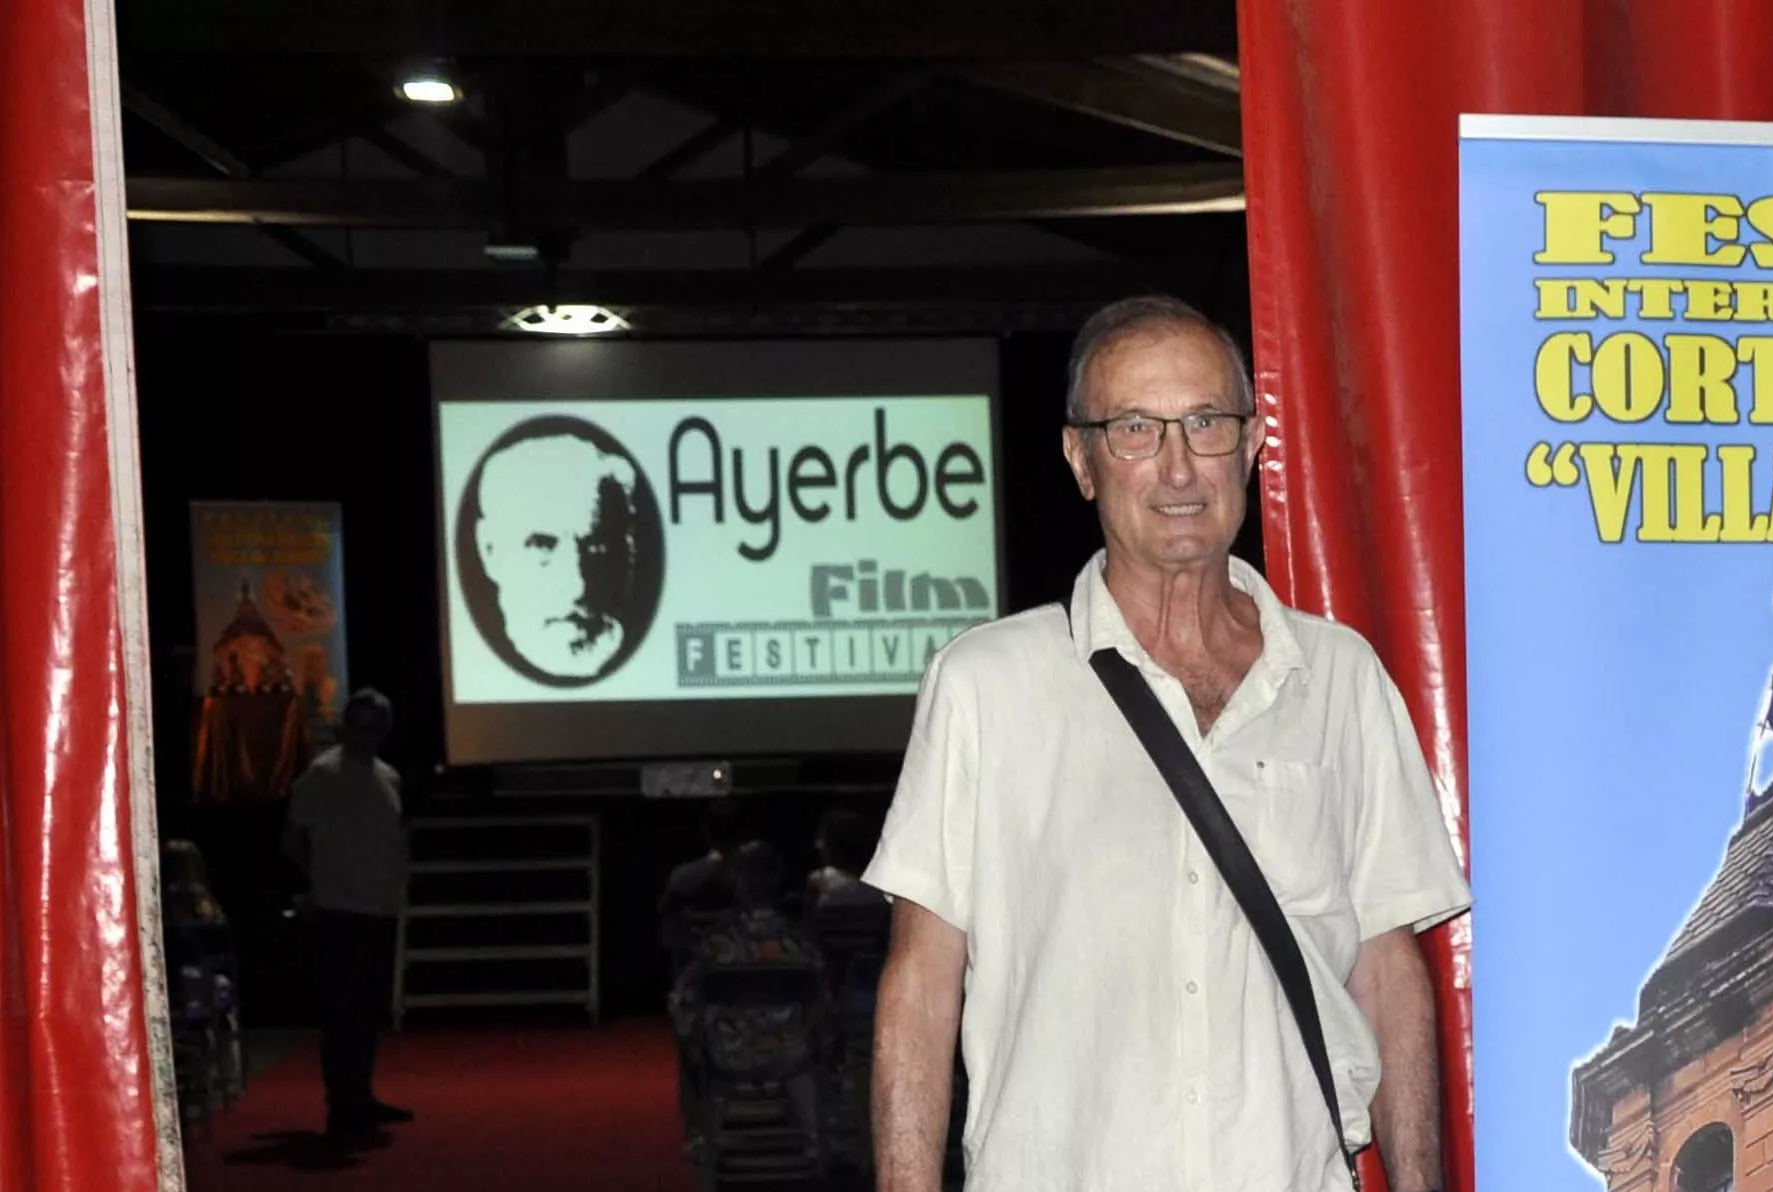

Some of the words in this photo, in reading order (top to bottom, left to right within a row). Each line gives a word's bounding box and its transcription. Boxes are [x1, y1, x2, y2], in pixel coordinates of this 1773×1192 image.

[669, 406, 987, 562] Ayerbe
[810, 559, 992, 617] Film
[680, 630, 940, 677] FESTIVA
